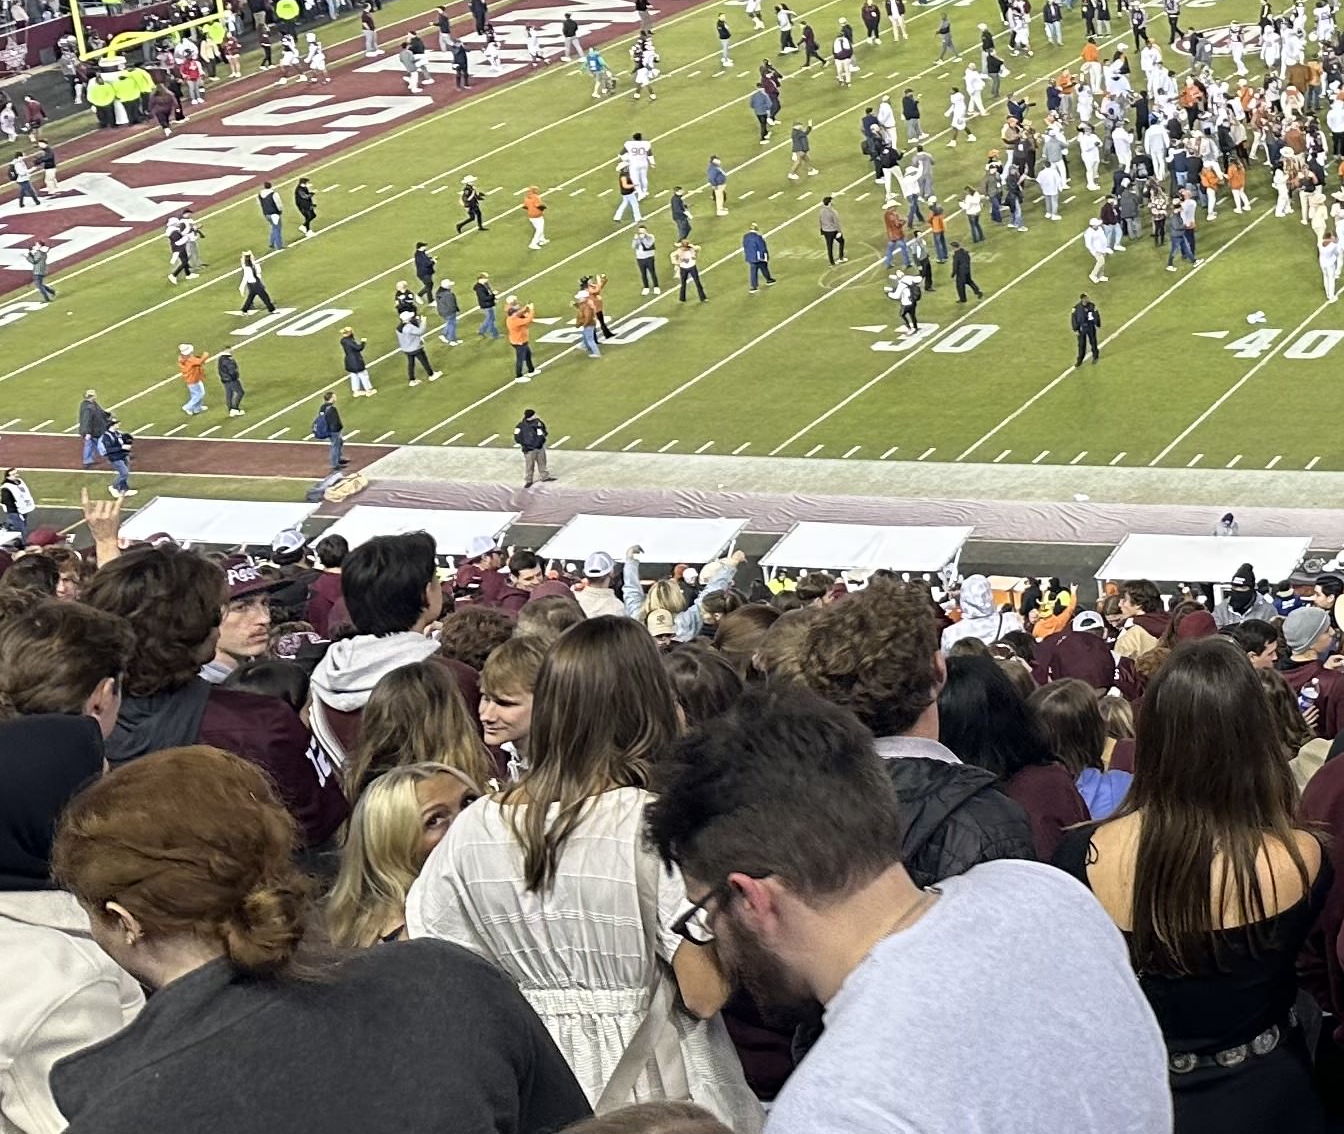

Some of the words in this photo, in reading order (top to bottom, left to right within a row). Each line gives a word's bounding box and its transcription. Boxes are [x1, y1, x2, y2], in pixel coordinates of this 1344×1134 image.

[630, 147, 647, 156] 90
[230, 307, 354, 337] 10
[871, 323, 1000, 353] 30
